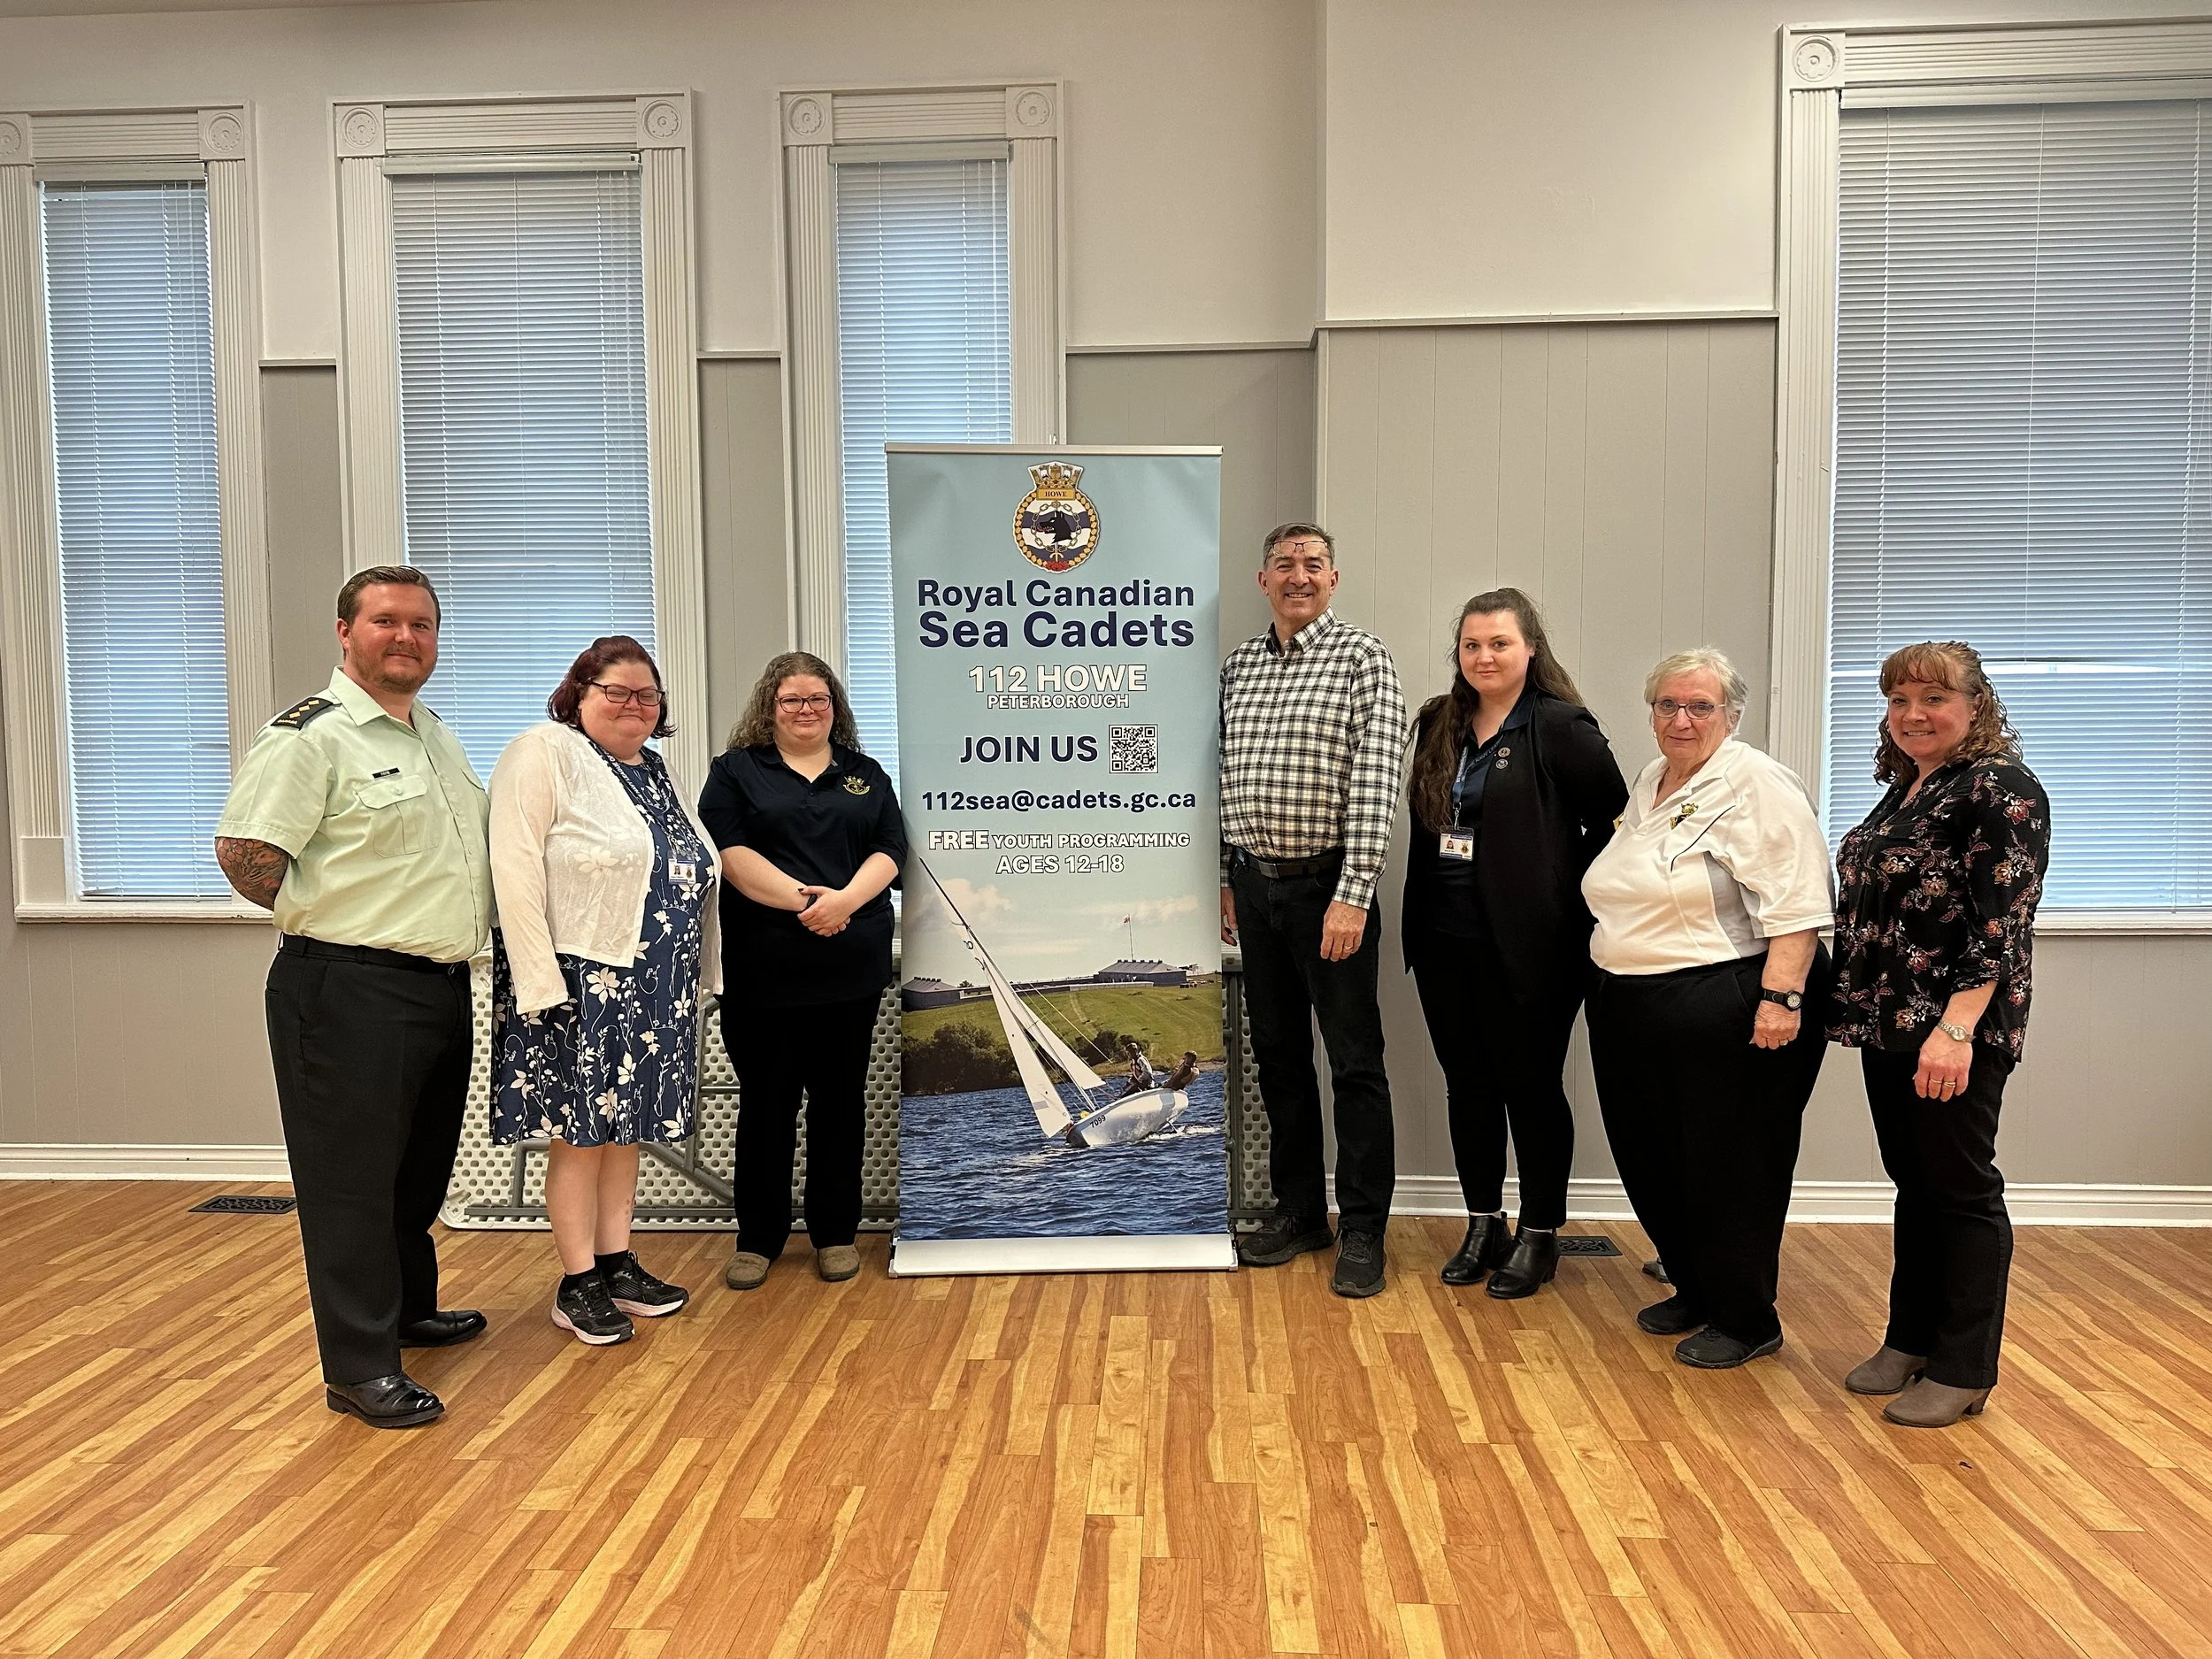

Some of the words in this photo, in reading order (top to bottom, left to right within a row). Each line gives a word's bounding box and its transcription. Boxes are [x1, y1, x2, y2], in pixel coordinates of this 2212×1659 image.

[918, 580, 1017, 612] Royal
[1026, 580, 1194, 606] Canadian
[919, 611, 1008, 648] Sea
[1024, 611, 1194, 648] Cadets
[969, 665, 1028, 692] 112
[1037, 664, 1147, 692] HOWE
[987, 694, 1130, 709] PETERBOROUGH
[960, 736, 1041, 763] JOIN
[1051, 735, 1098, 763] US
[922, 790, 1196, 812] 112sea@cadets.gc.ca
[929, 830, 989, 849] FREE
[993, 834, 1052, 849] YOUTH
[1058, 833, 1190, 848] PROGRAMMING
[995, 855, 1060, 874] AGES
[1064, 855, 1125, 873] 12-18
[1089, 1114, 1106, 1128] 7099
